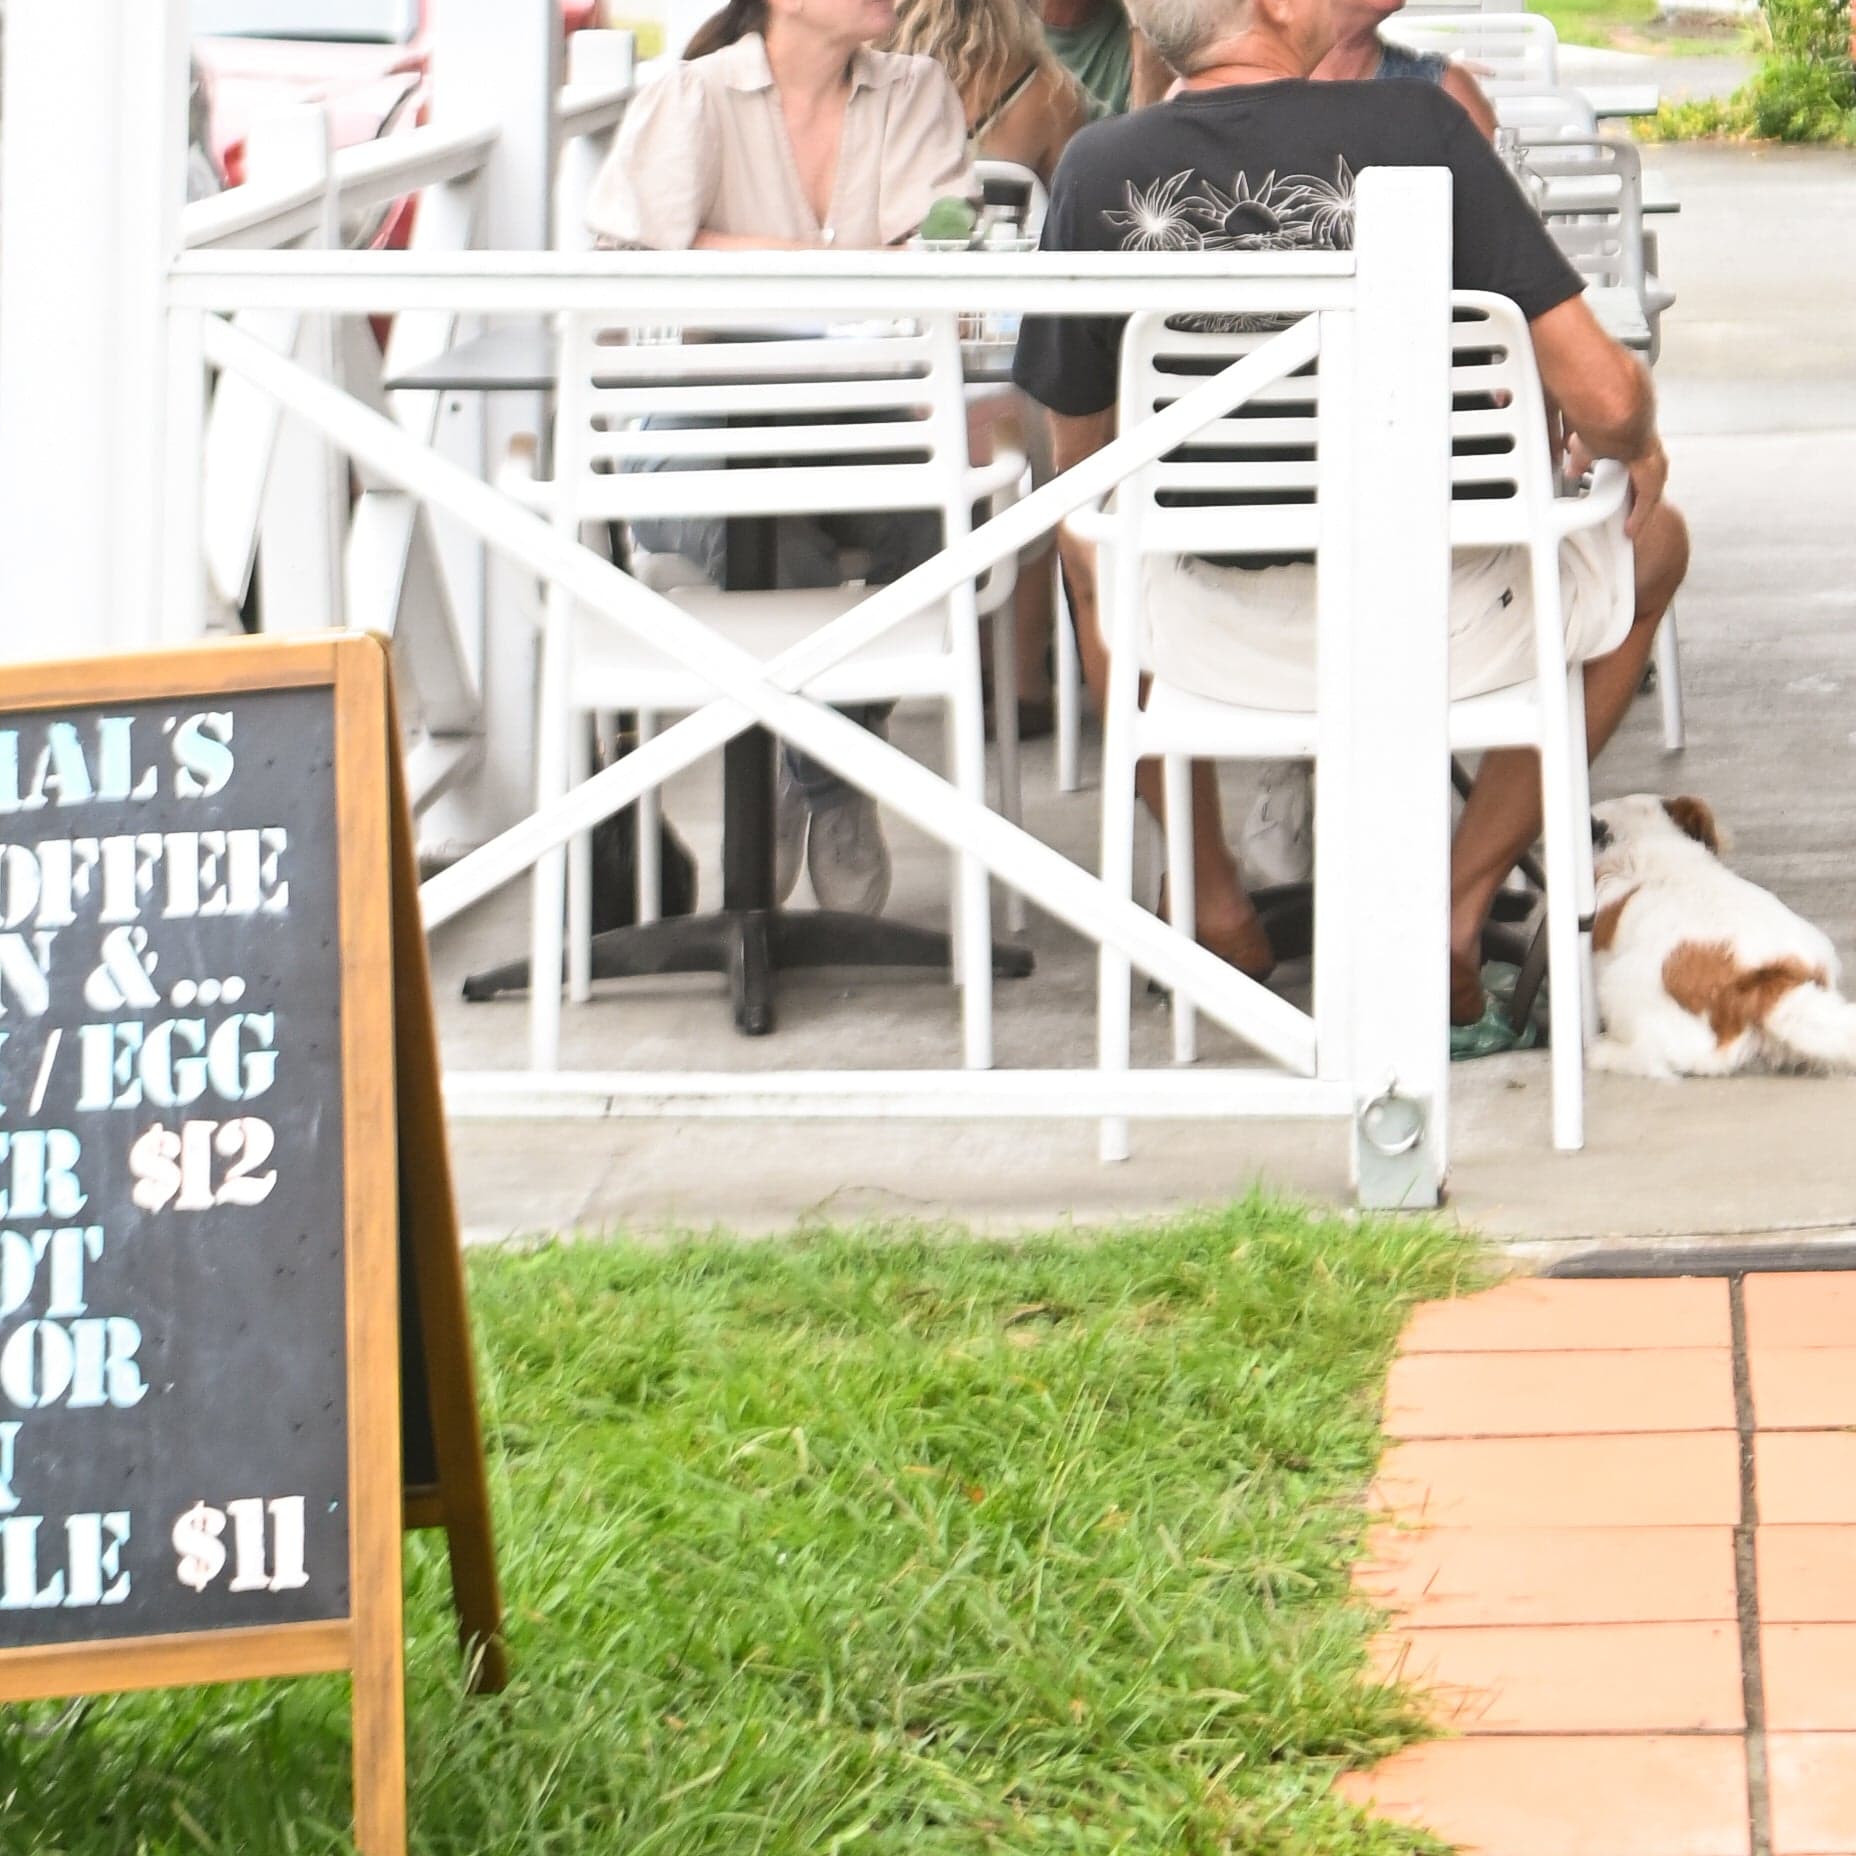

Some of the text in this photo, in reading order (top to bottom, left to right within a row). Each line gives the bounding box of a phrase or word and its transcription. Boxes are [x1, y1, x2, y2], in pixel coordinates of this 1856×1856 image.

[0, 1116, 277, 1219] R $12
[172, 1496, 309, 1592] $11
